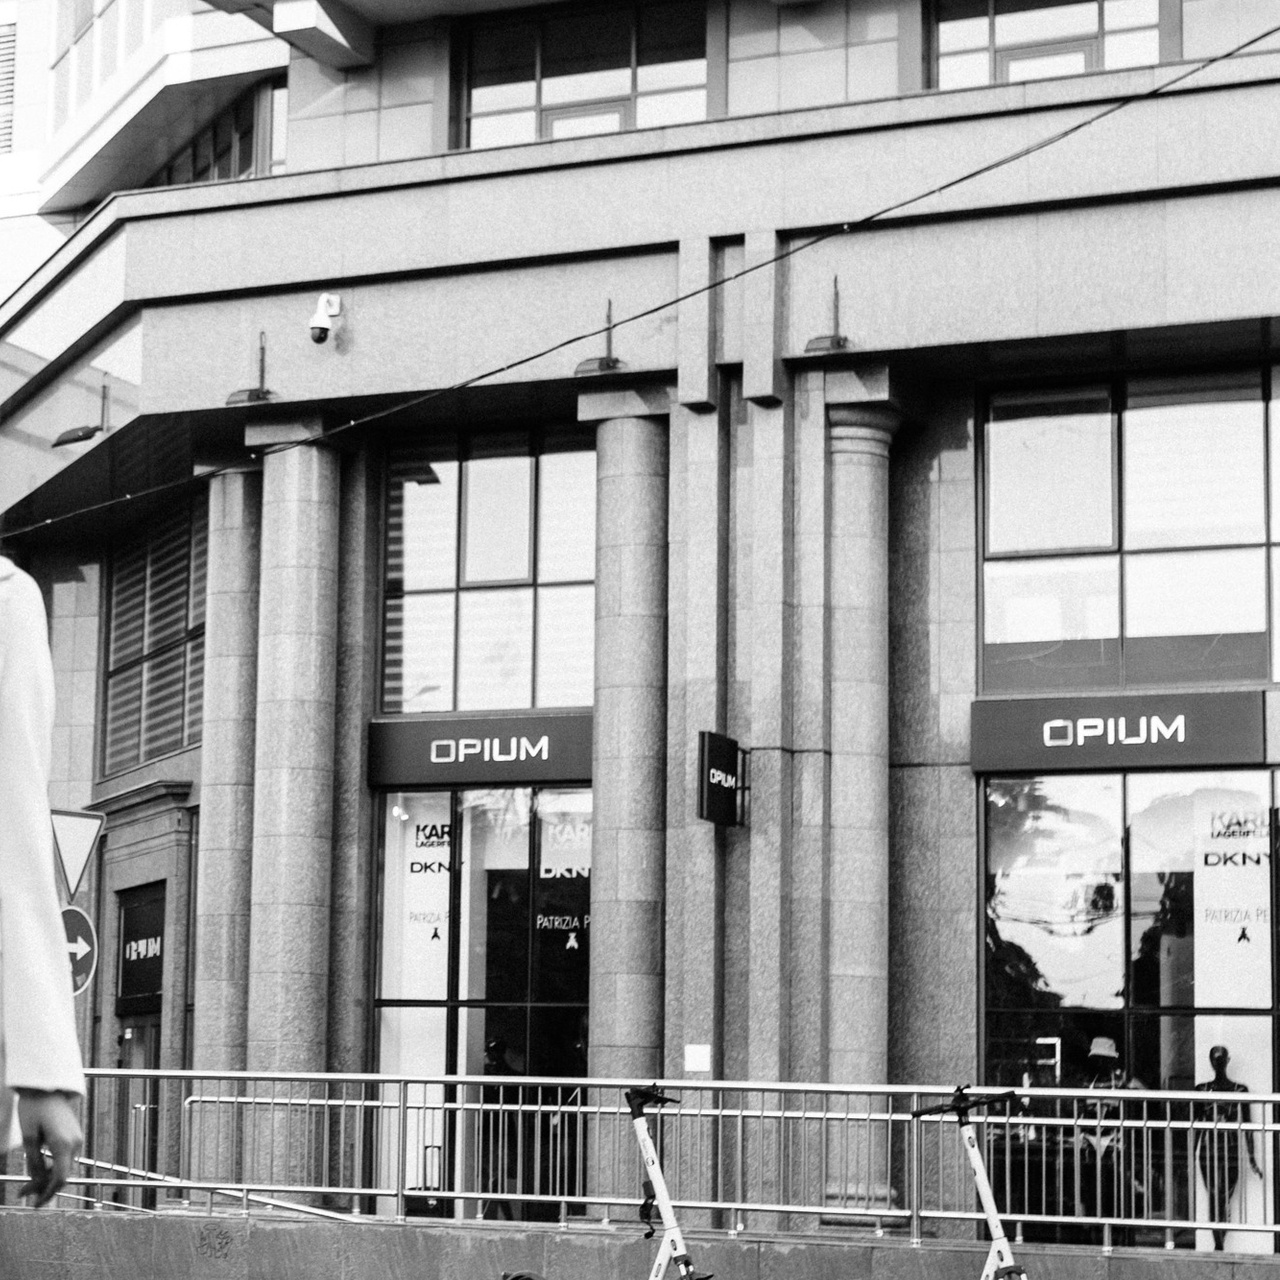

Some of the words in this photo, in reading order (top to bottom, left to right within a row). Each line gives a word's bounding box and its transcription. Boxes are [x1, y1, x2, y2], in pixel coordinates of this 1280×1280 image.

[1043, 714, 1185, 747] OPIUM
[430, 735, 549, 763] OPIUM
[710, 767, 736, 789] OPIUM
[416, 824, 451, 840] KAR
[548, 823, 591, 843] KAR
[410, 861, 464, 873] DKN
[540, 865, 590, 878] DKN
[536, 914, 580, 929] PATRIZIA
